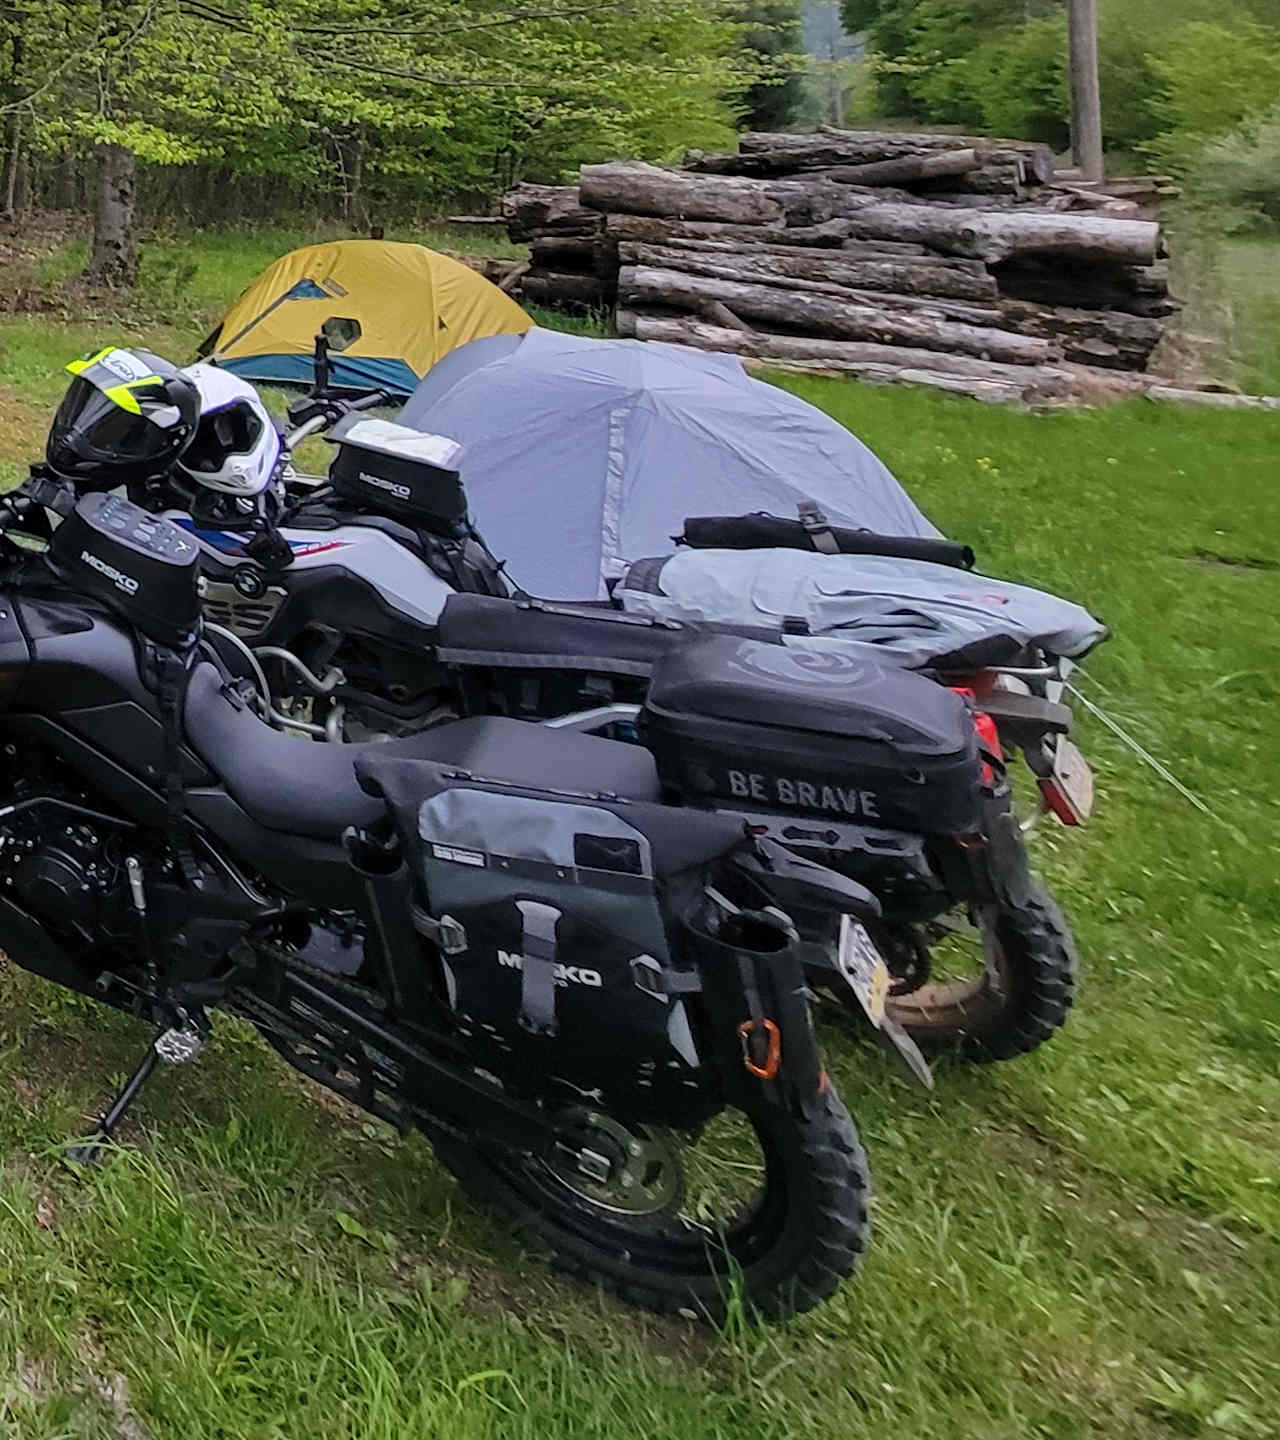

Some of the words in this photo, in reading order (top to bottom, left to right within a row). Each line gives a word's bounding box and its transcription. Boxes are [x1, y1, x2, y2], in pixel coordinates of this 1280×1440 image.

[81, 550, 139, 592] MOSKO
[728, 770, 768, 801] BE
[776, 777, 881, 818] BRAVE
[497, 949, 603, 987] MSKO
